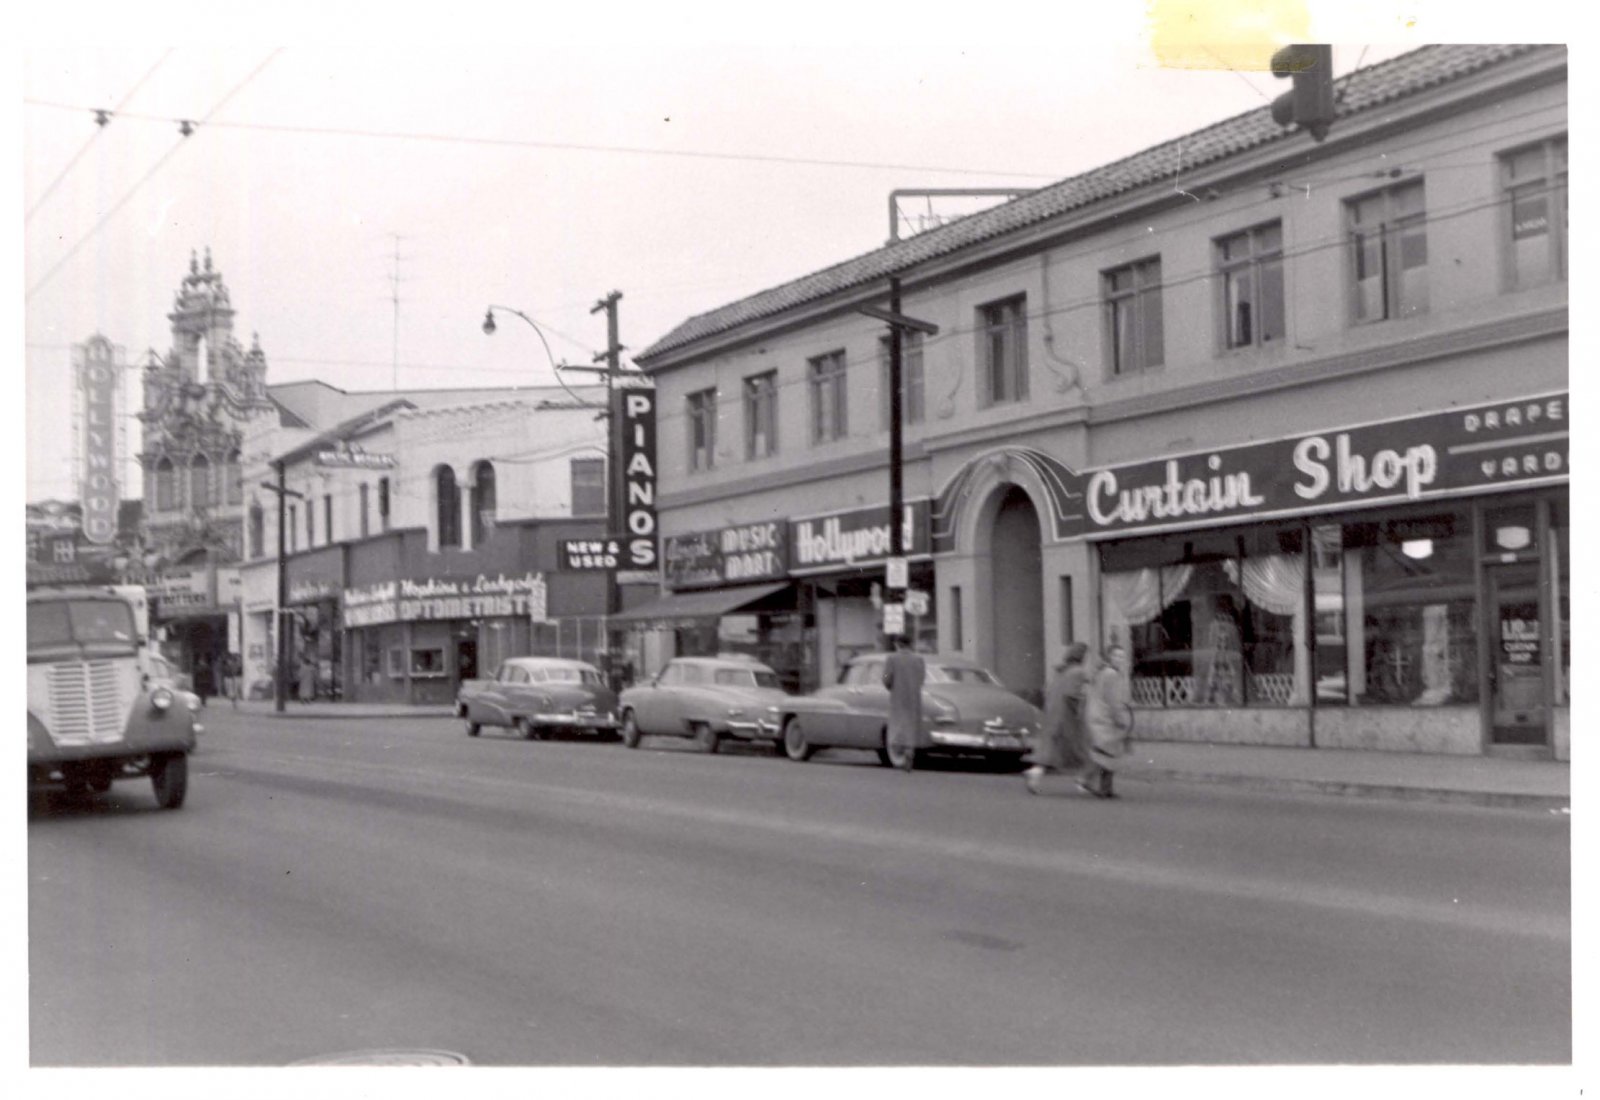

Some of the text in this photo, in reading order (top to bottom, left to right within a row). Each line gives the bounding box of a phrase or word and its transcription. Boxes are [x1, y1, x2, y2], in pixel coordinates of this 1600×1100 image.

[1463, 399, 1563, 433] DRAPE
[88, 343, 110, 532] HOLLYWOOD
[626, 394, 655, 565] PIANOS
[1087, 433, 1437, 525] Curtain Shop
[1481, 451, 1568, 478] YARD
[566, 541, 620, 554] NEW &
[721, 522, 777, 553] MUSIC
[568, 554, 617, 569] USED
[724, 551, 774, 580] MART
